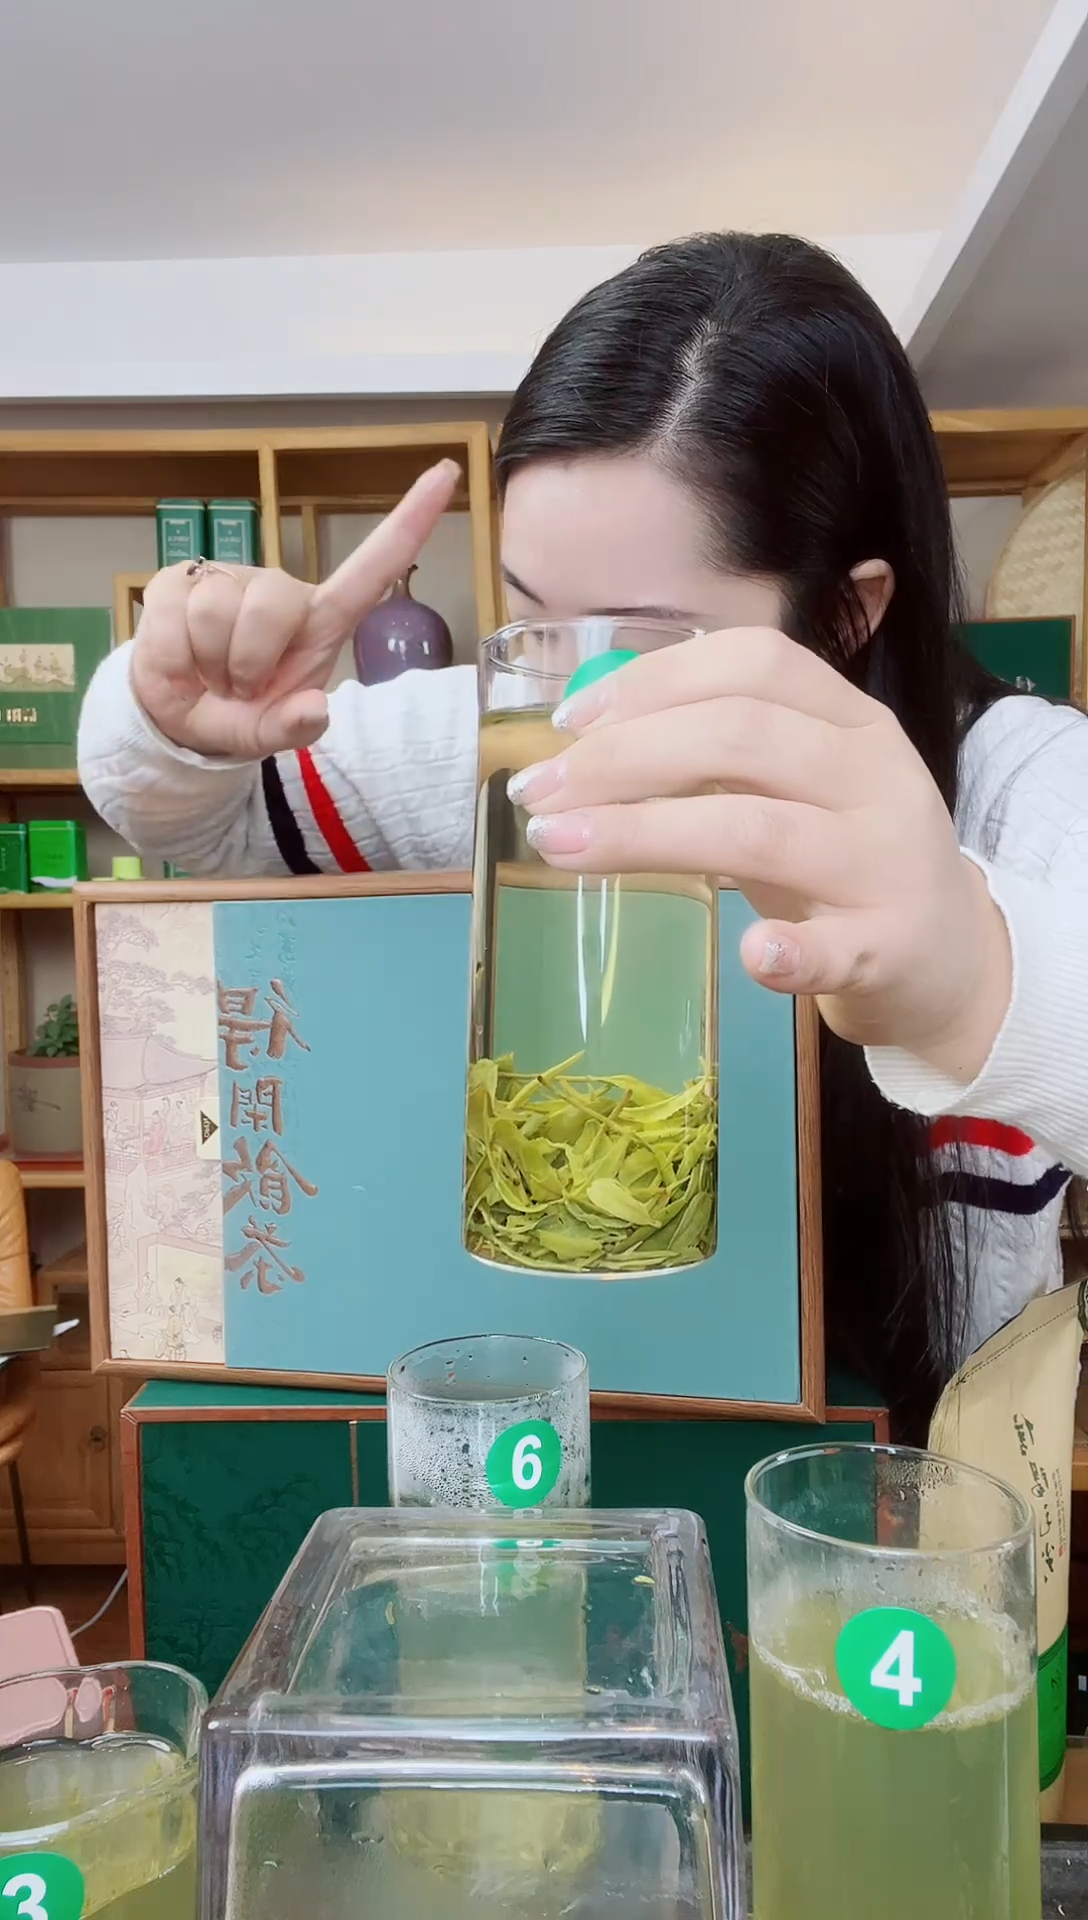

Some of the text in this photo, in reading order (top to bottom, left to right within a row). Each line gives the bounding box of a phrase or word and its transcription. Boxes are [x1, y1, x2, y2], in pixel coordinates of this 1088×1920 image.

[512, 1434, 543, 1491] 6
[870, 1630, 922, 1707] 4
[2, 1873, 49, 1920] 3
